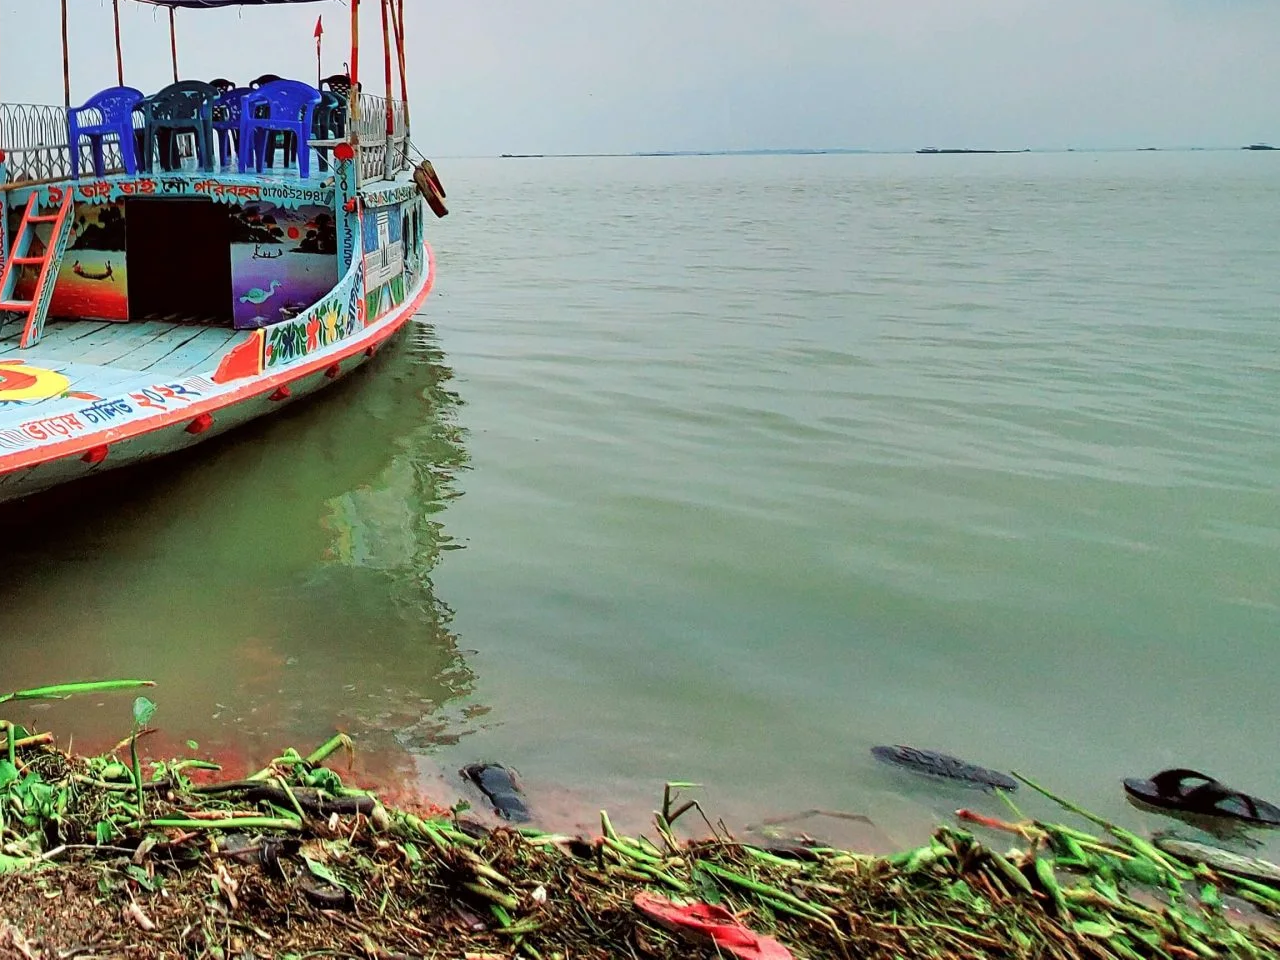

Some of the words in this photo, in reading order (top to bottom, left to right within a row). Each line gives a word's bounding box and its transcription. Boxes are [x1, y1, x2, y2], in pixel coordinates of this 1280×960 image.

[117, 177, 158, 195] ভাই
[263, 187, 324, 201] 01700-521981
[78, 398, 133, 424] চালিত
